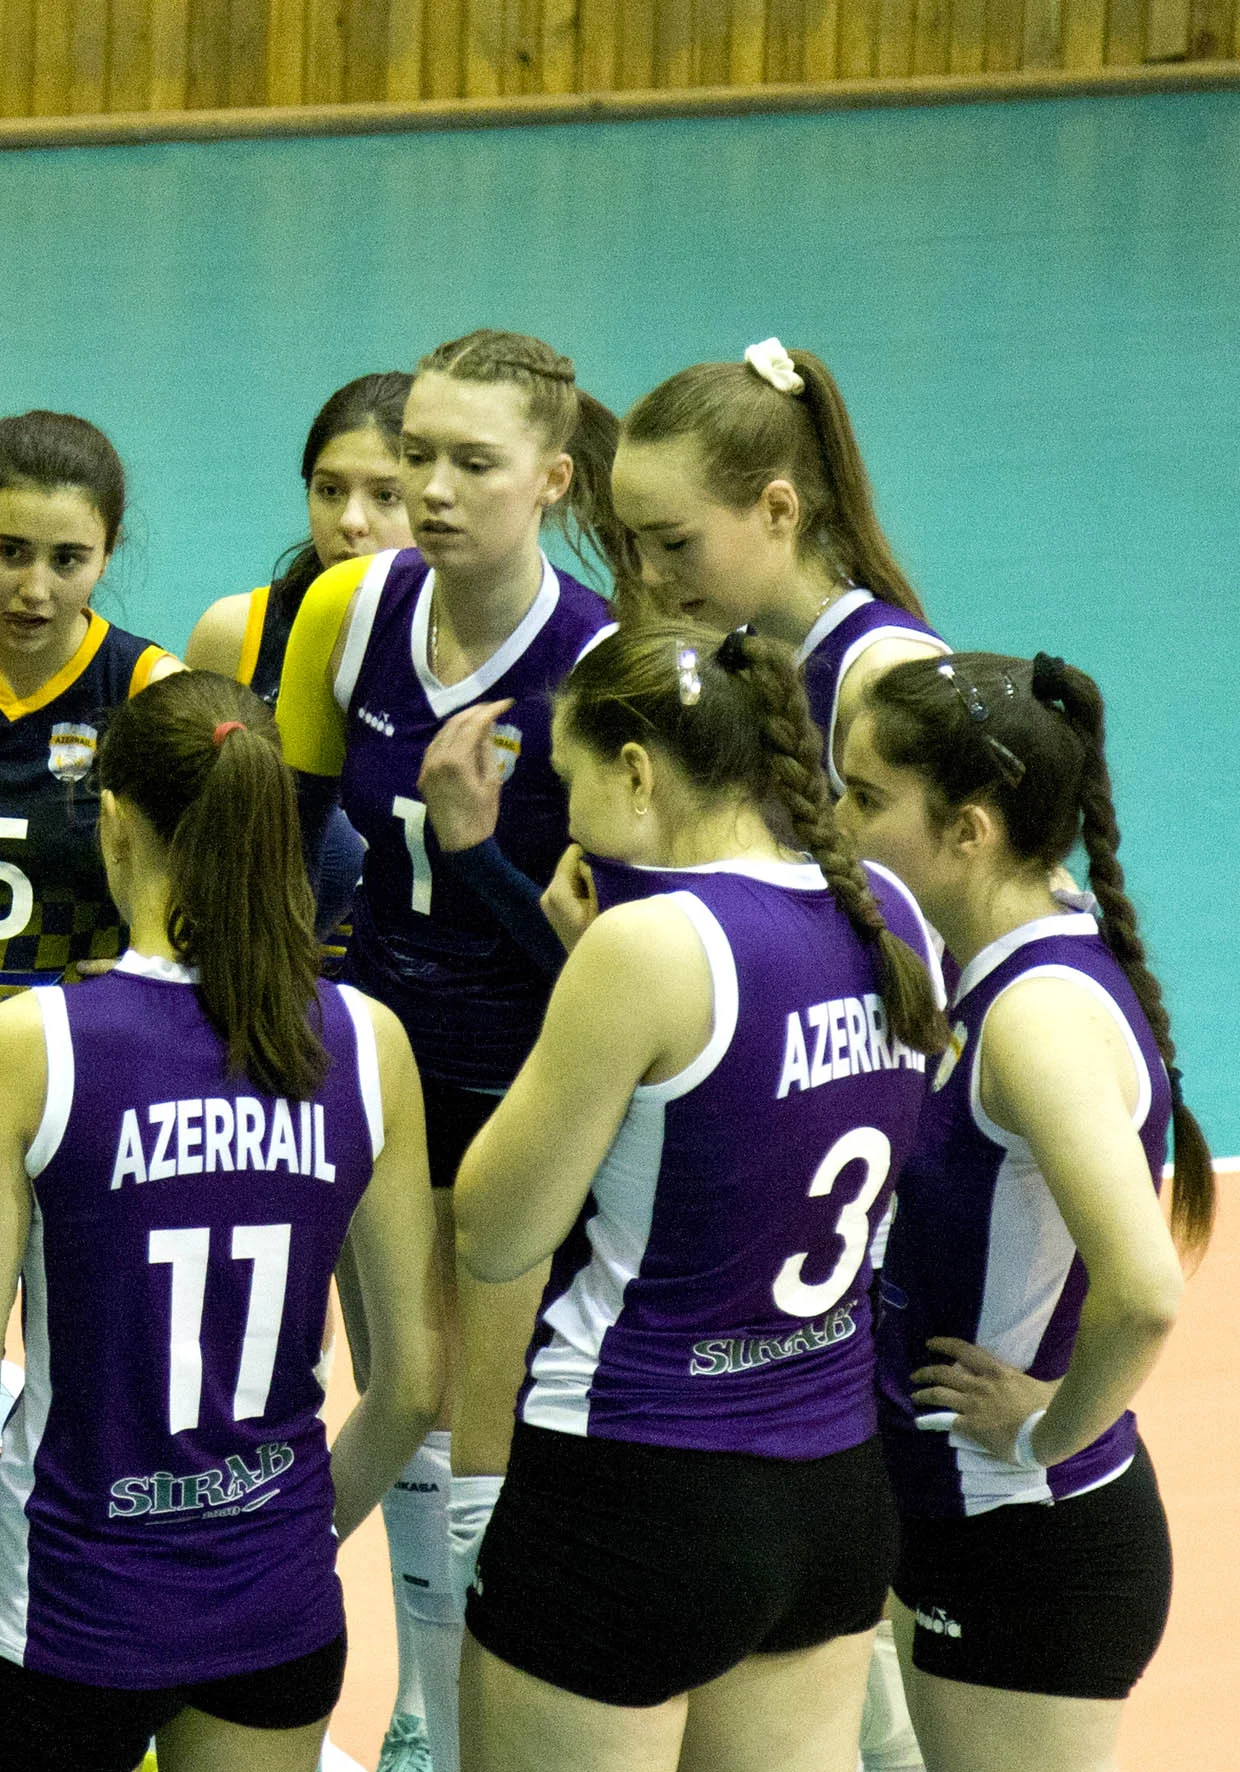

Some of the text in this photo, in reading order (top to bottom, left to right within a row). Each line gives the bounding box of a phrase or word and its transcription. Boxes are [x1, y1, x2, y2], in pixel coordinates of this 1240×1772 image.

[111, 1097, 336, 1190] AZERRAIL
[772, 1127, 891, 1317] 3
[148, 1224, 291, 1435] 11
